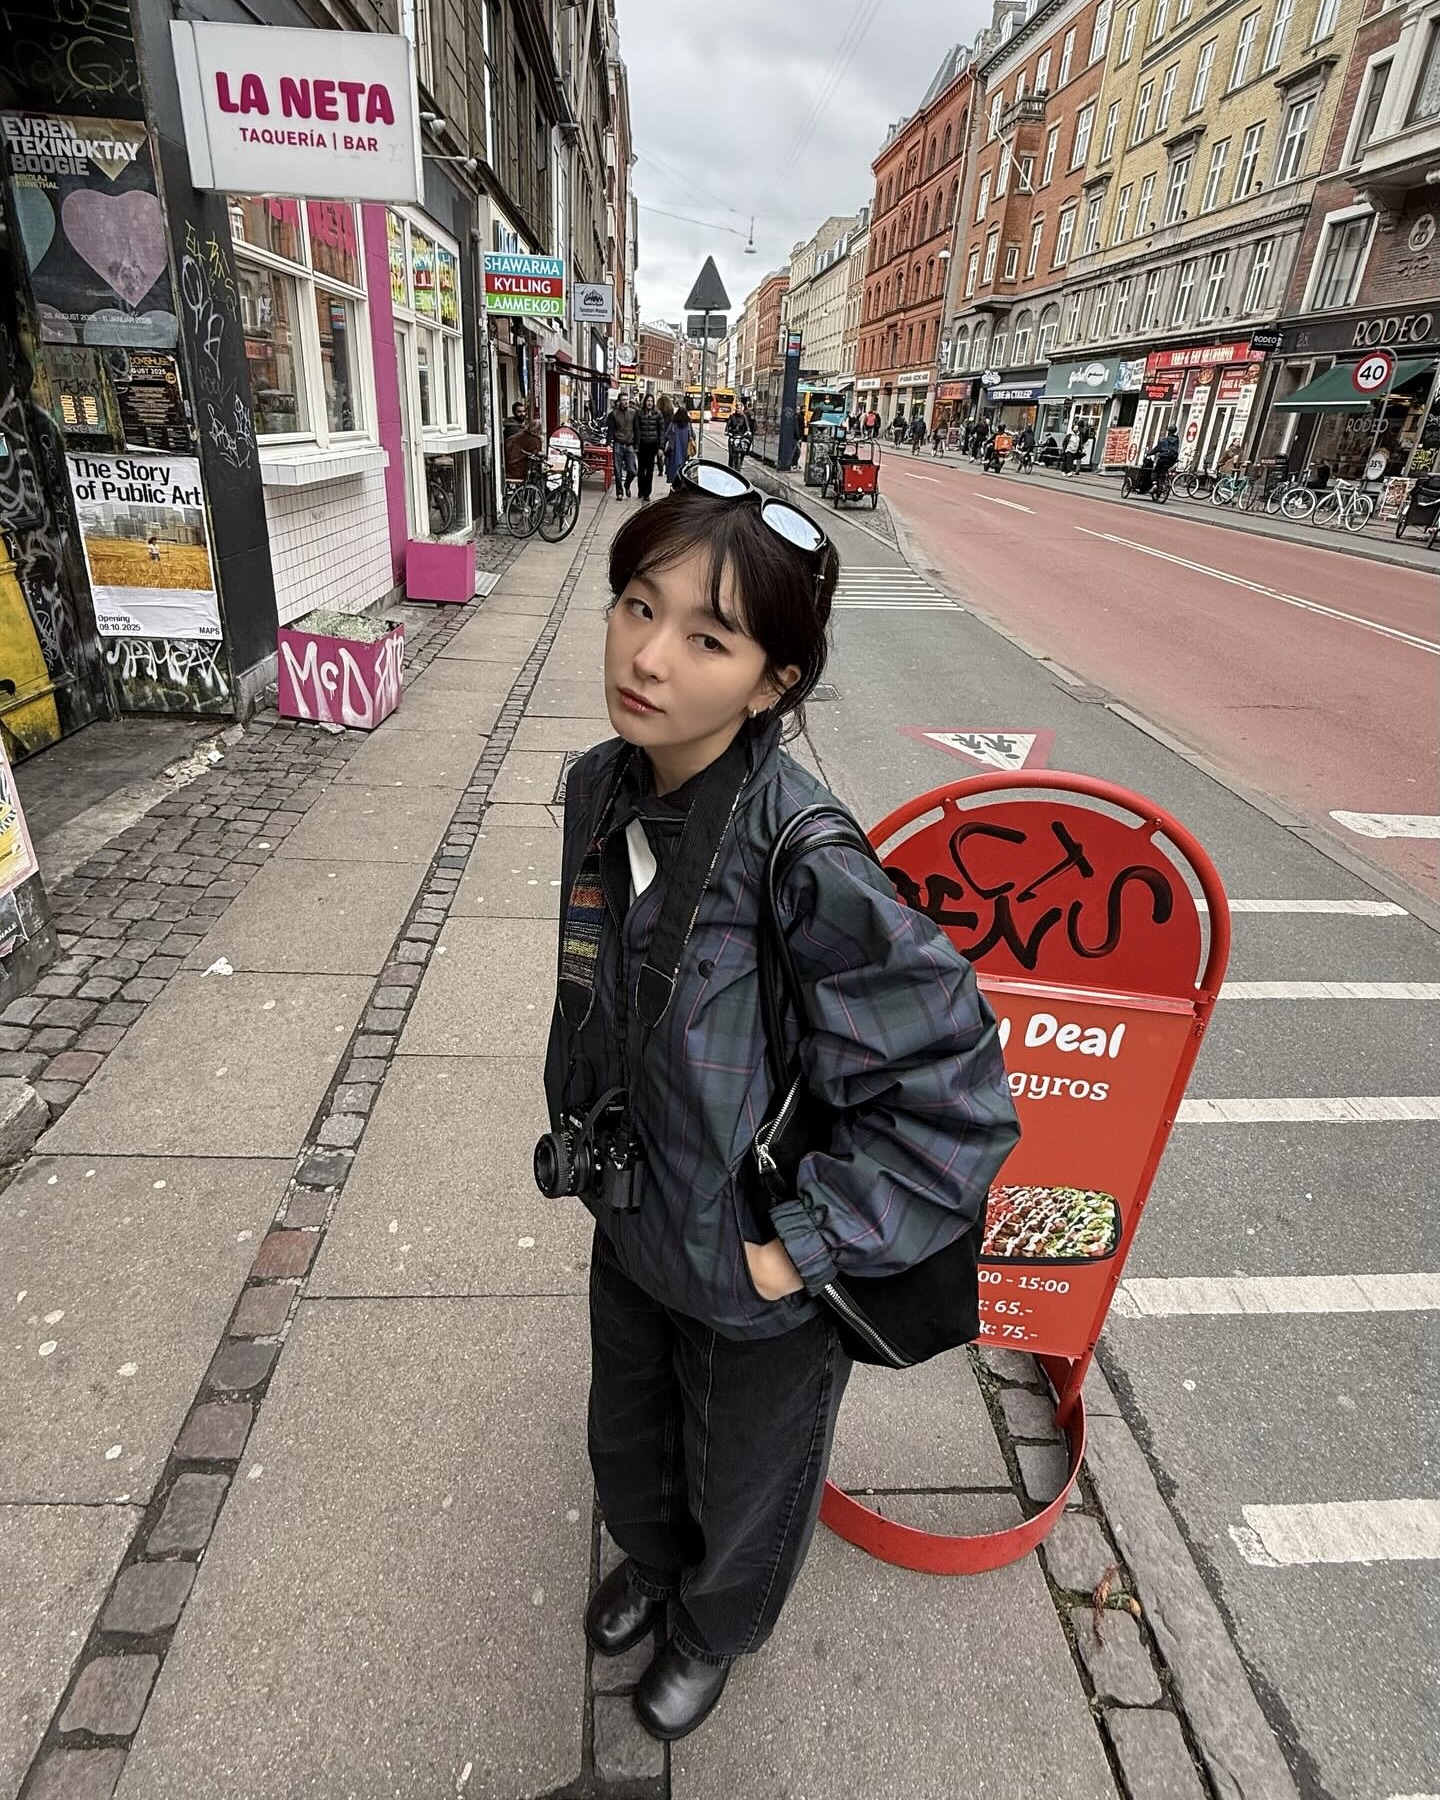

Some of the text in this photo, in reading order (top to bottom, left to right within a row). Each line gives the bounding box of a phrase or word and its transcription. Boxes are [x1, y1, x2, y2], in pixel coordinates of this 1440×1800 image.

[215, 71, 395, 125] LA NETA
[1, 115, 77, 138] EVREN
[6, 135, 139, 161] TEKINOKTAY
[239, 127, 328, 148] TAQUERÍA
[343, 135, 379, 151] BAR
[11, 153, 90, 176] BOOGIE
[485, 256, 560, 275] SHAWARMA
[494, 277, 551, 294] KYLLING
[486, 295, 560, 313] LAMMEKØD
[1351, 312, 1435, 347] RODEO
[1254, 335, 1278, 345] RODEO
[1359, 365, 1385, 381] 40
[1345, 418, 1389, 434] RODEO
[70, 457, 170, 486] The Story
[76, 480, 203, 506] of Public Art
[98, 615, 130, 623] Opening
[99, 623, 141, 632] 09.10.2025
[199, 627, 220, 635] MAPS
[1025, 1013, 1126, 1058] Deal
[1007, 1072, 1110, 1101] gyros
[1017, 1276, 1070, 1294] 15:00
[994, 1300, 1033, 1316] 65.-
[1002, 1324, 1038, 1340] 75.-
